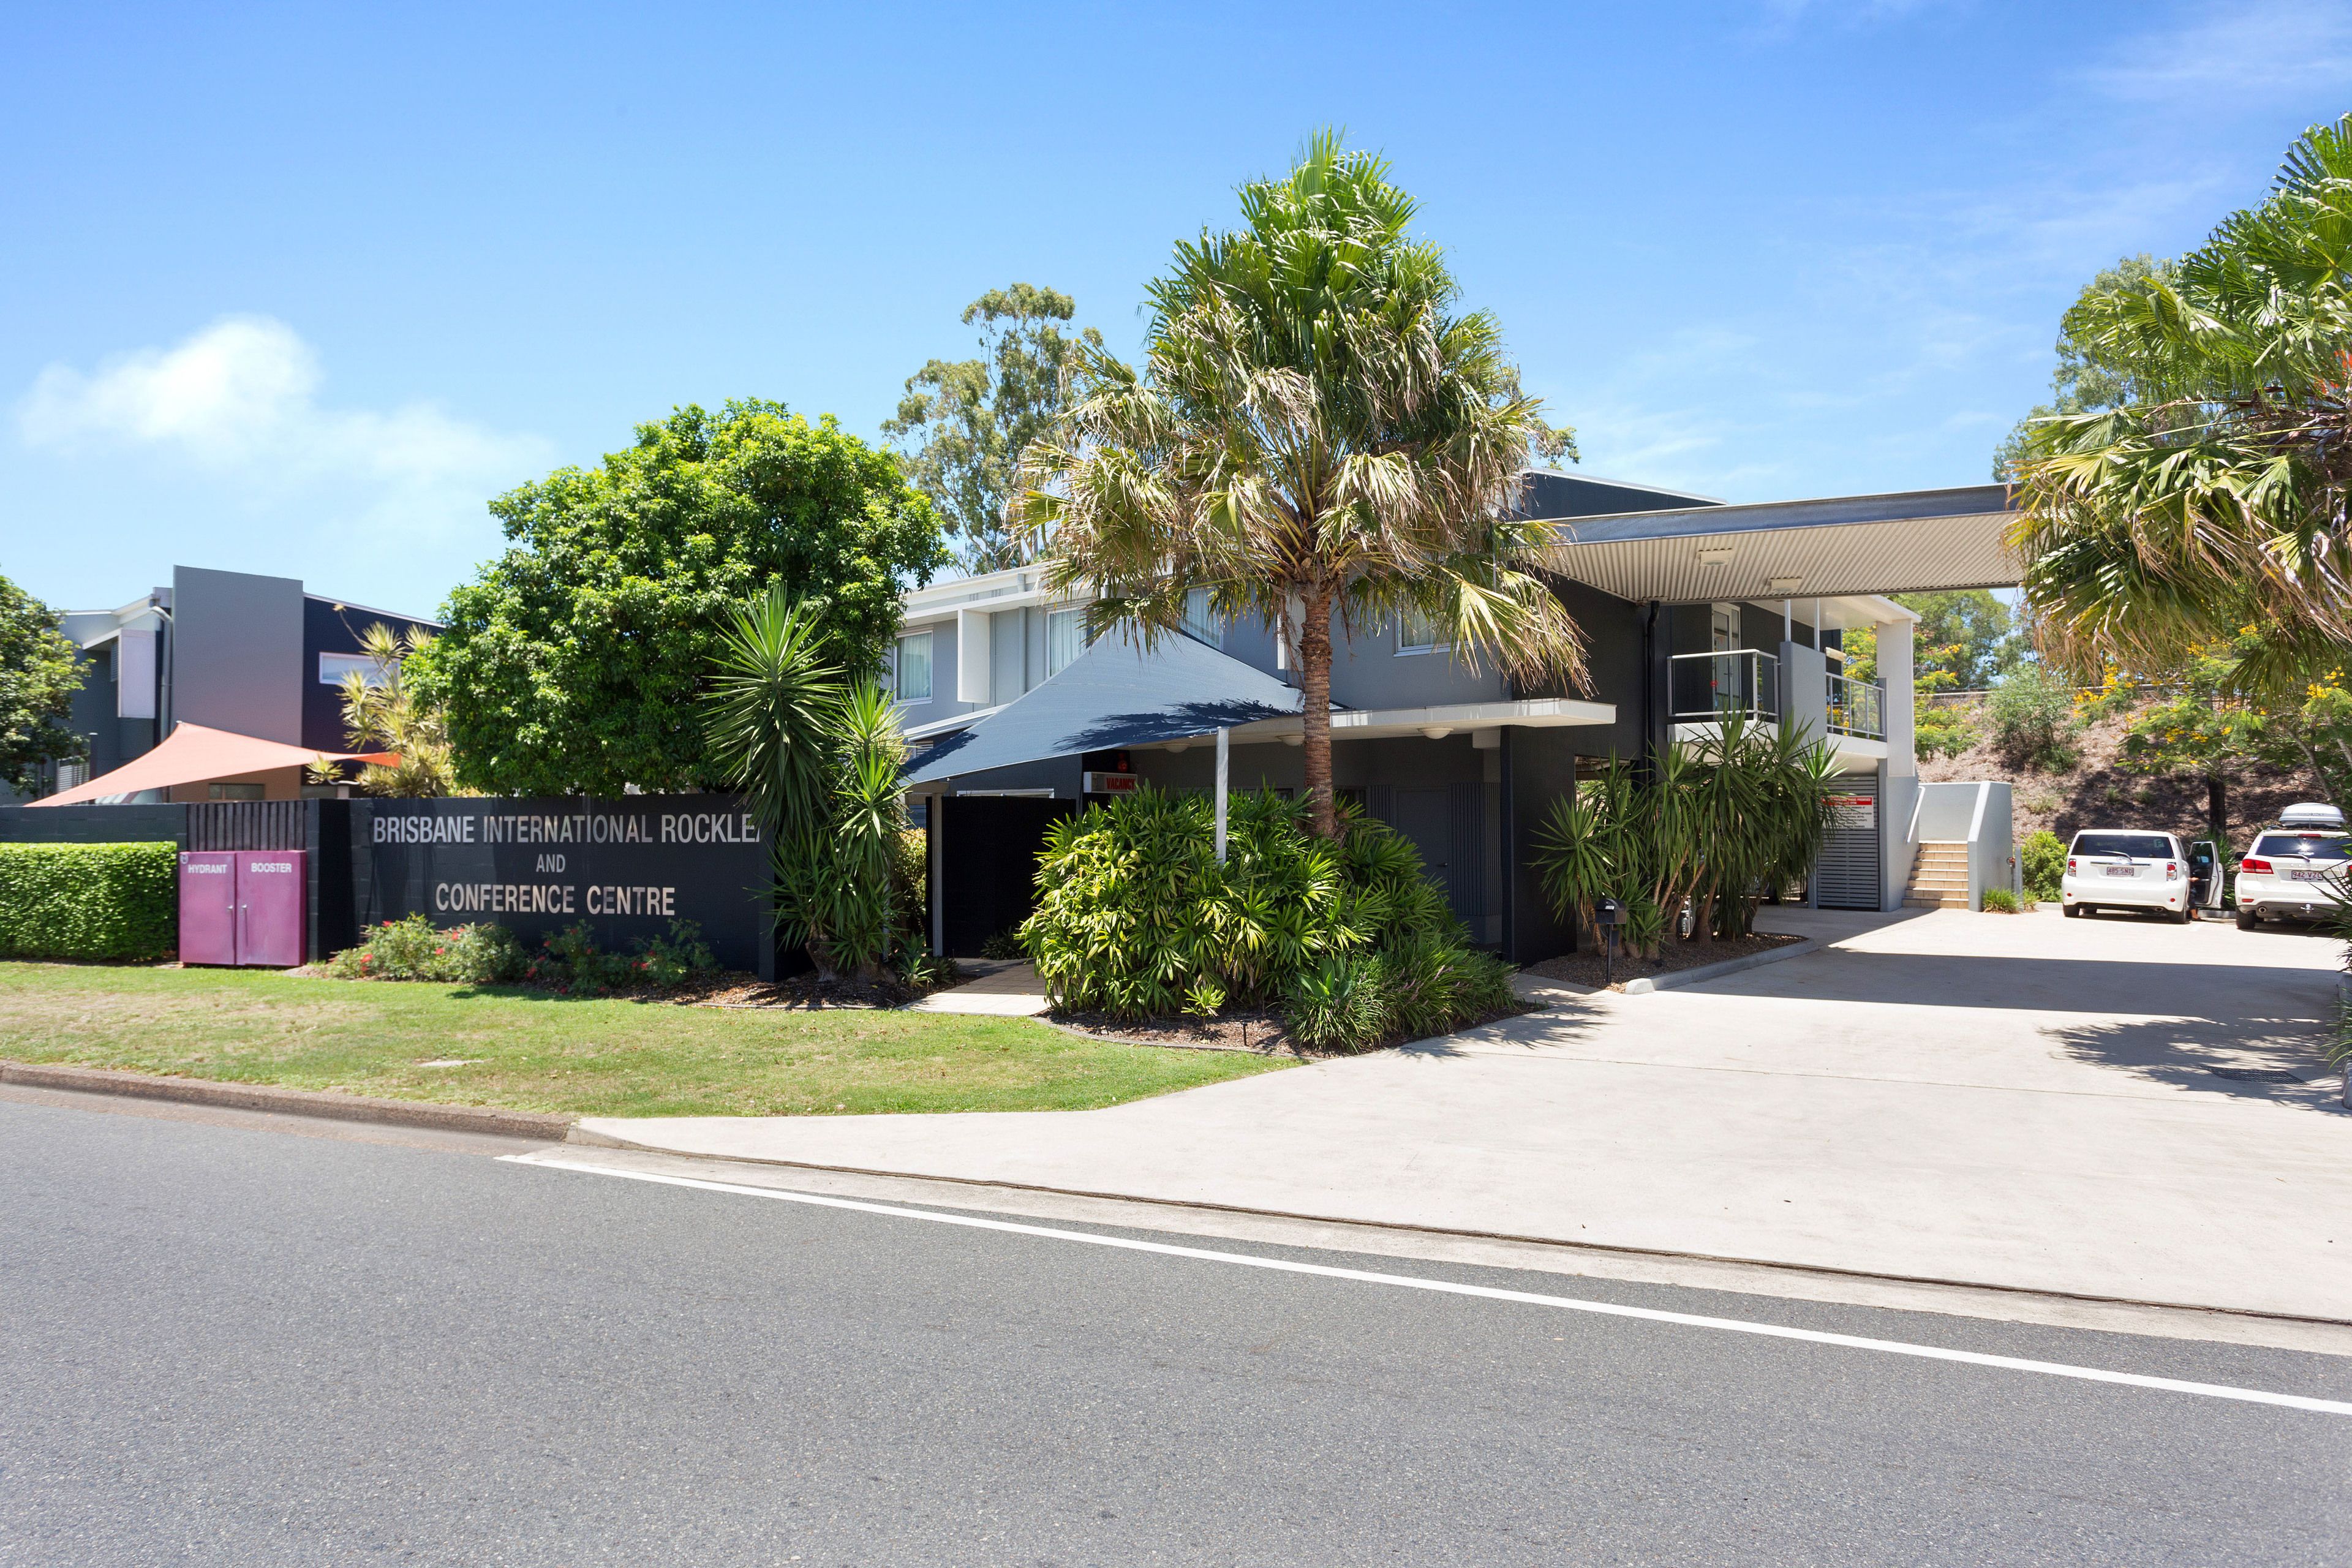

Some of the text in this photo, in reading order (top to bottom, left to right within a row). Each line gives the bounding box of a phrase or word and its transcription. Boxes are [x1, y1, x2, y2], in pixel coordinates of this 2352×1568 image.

[1107, 777, 1135, 790] VACANCY
[374, 813, 760, 843] BRISBANE INTERNATIONAL ROCKLE
[187, 864, 227, 874] HYDRANT
[251, 862, 292, 873] BOOSTER
[536, 854, 565, 873] AND
[435, 883, 675, 916] CONFERENCE CENTRE
